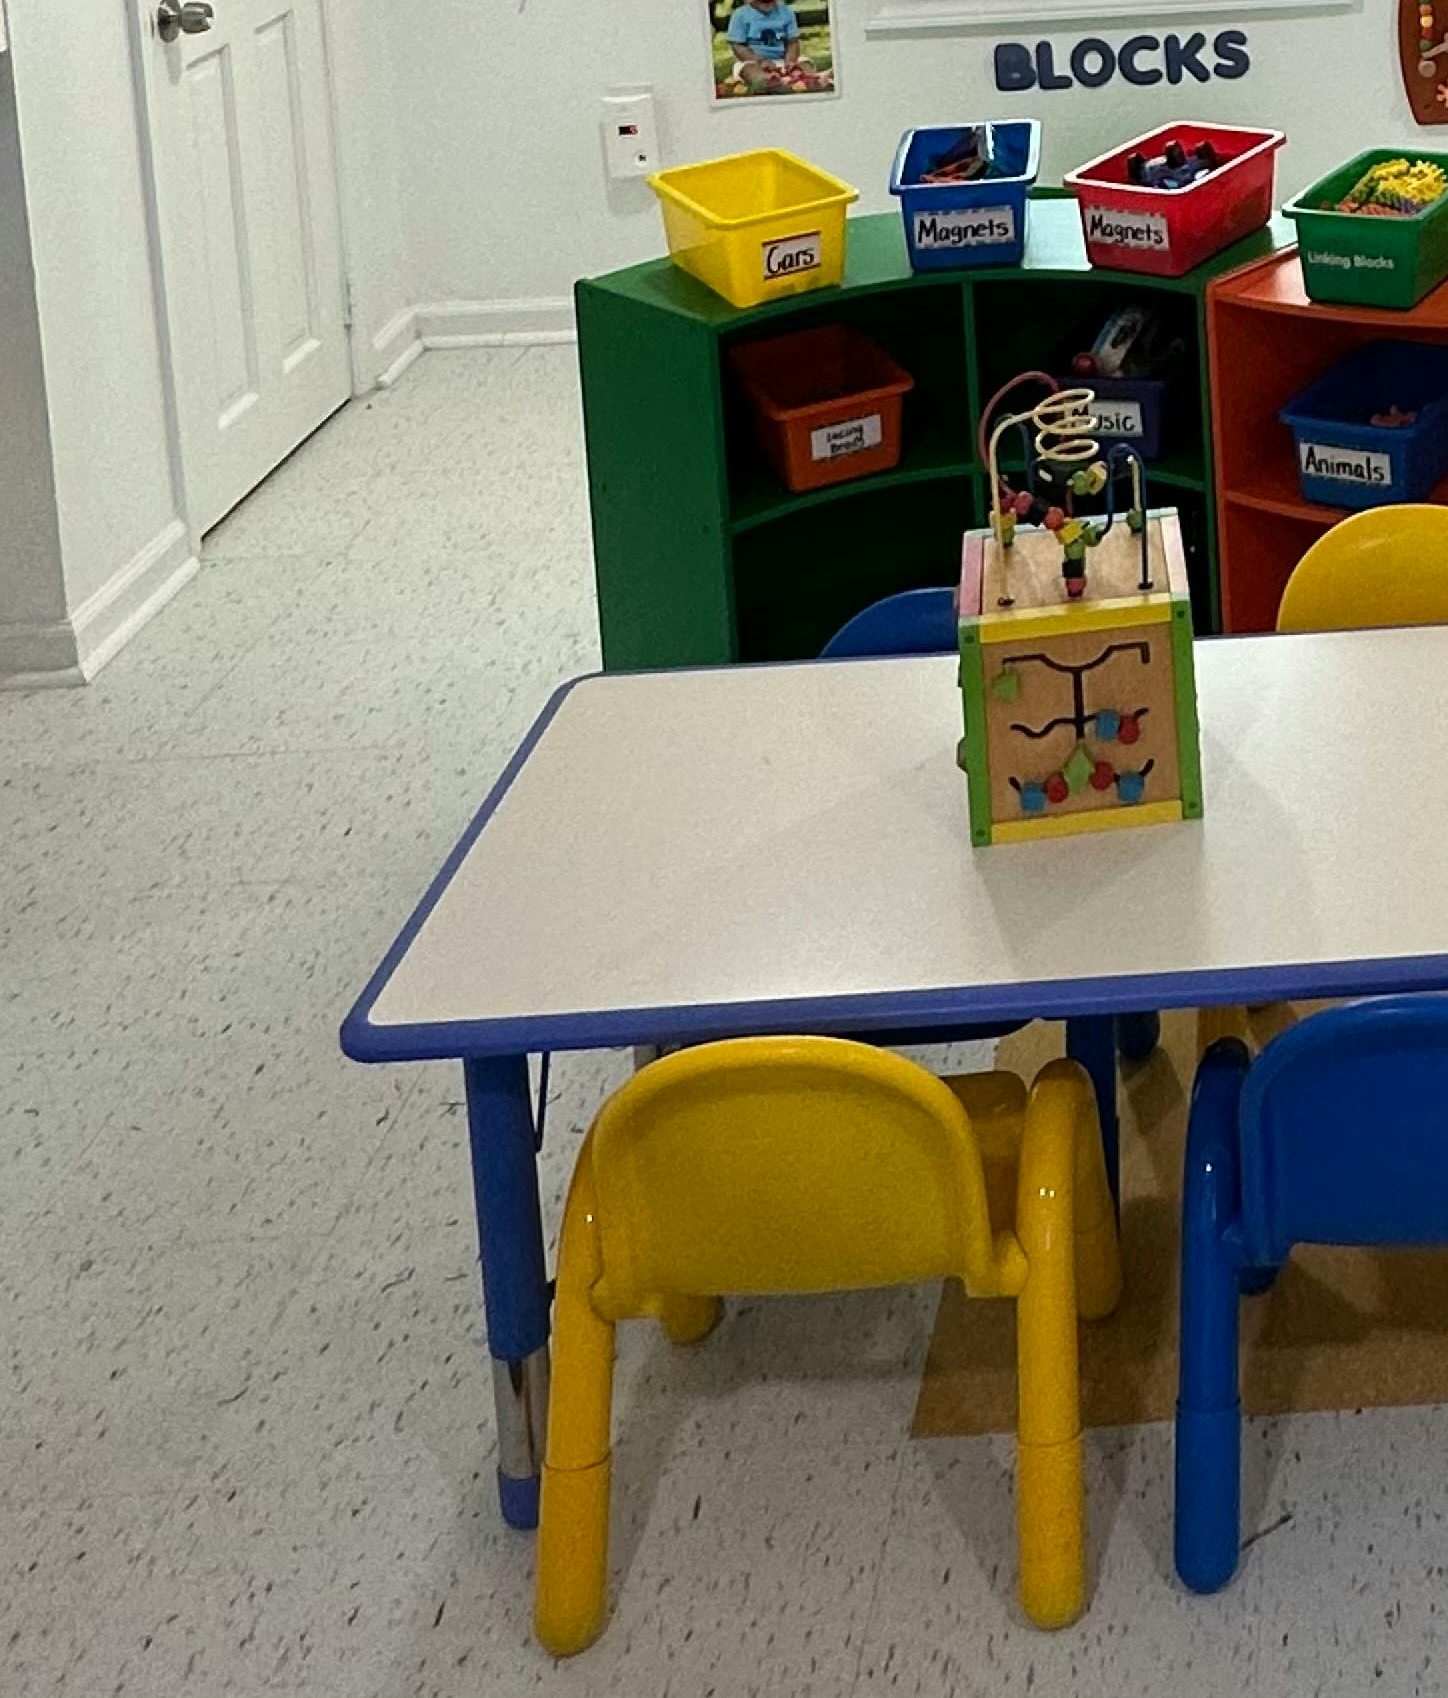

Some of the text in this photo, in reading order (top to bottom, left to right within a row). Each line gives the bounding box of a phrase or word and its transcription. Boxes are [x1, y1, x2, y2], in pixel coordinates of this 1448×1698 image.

[993, 29, 1251, 92] BLOCKS
[917, 217, 1010, 245] Magnets
[1089, 214, 1164, 245] Magnets
[766, 245, 815, 274] Cars
[1307, 249, 1395, 270] Linking Blocks
[1305, 446, 1385, 482] Animals
